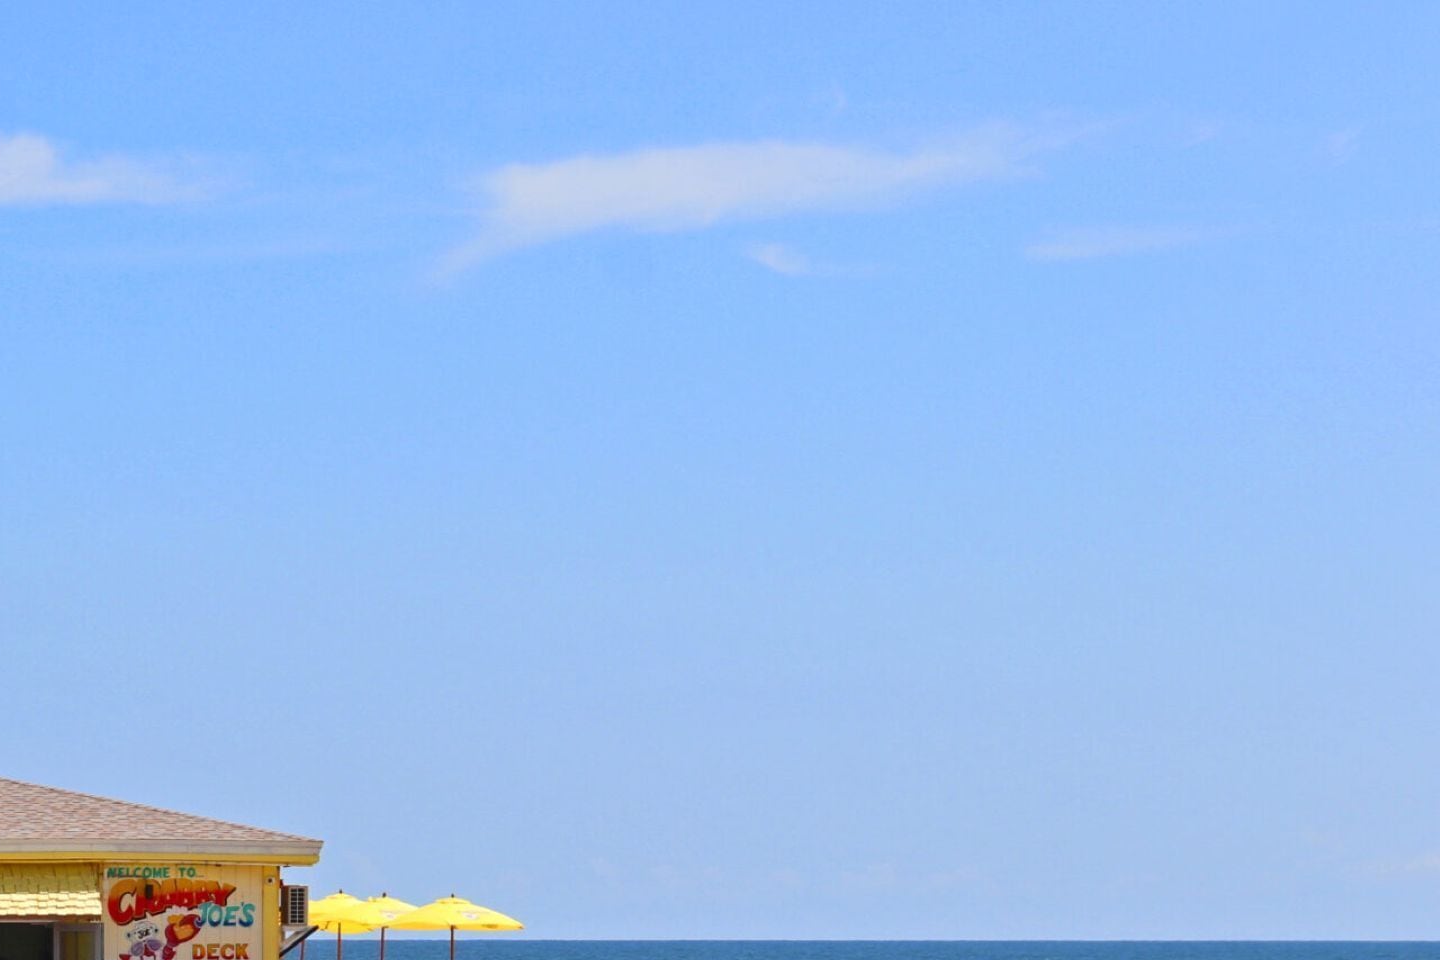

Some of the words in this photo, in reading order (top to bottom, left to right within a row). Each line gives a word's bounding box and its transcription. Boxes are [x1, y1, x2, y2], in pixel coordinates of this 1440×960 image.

[107, 867, 169, 878] WELCOME
[108, 878, 236, 926] CRABBY
[194, 902, 255, 927] JOE'S
[192, 943, 250, 960] DECK
